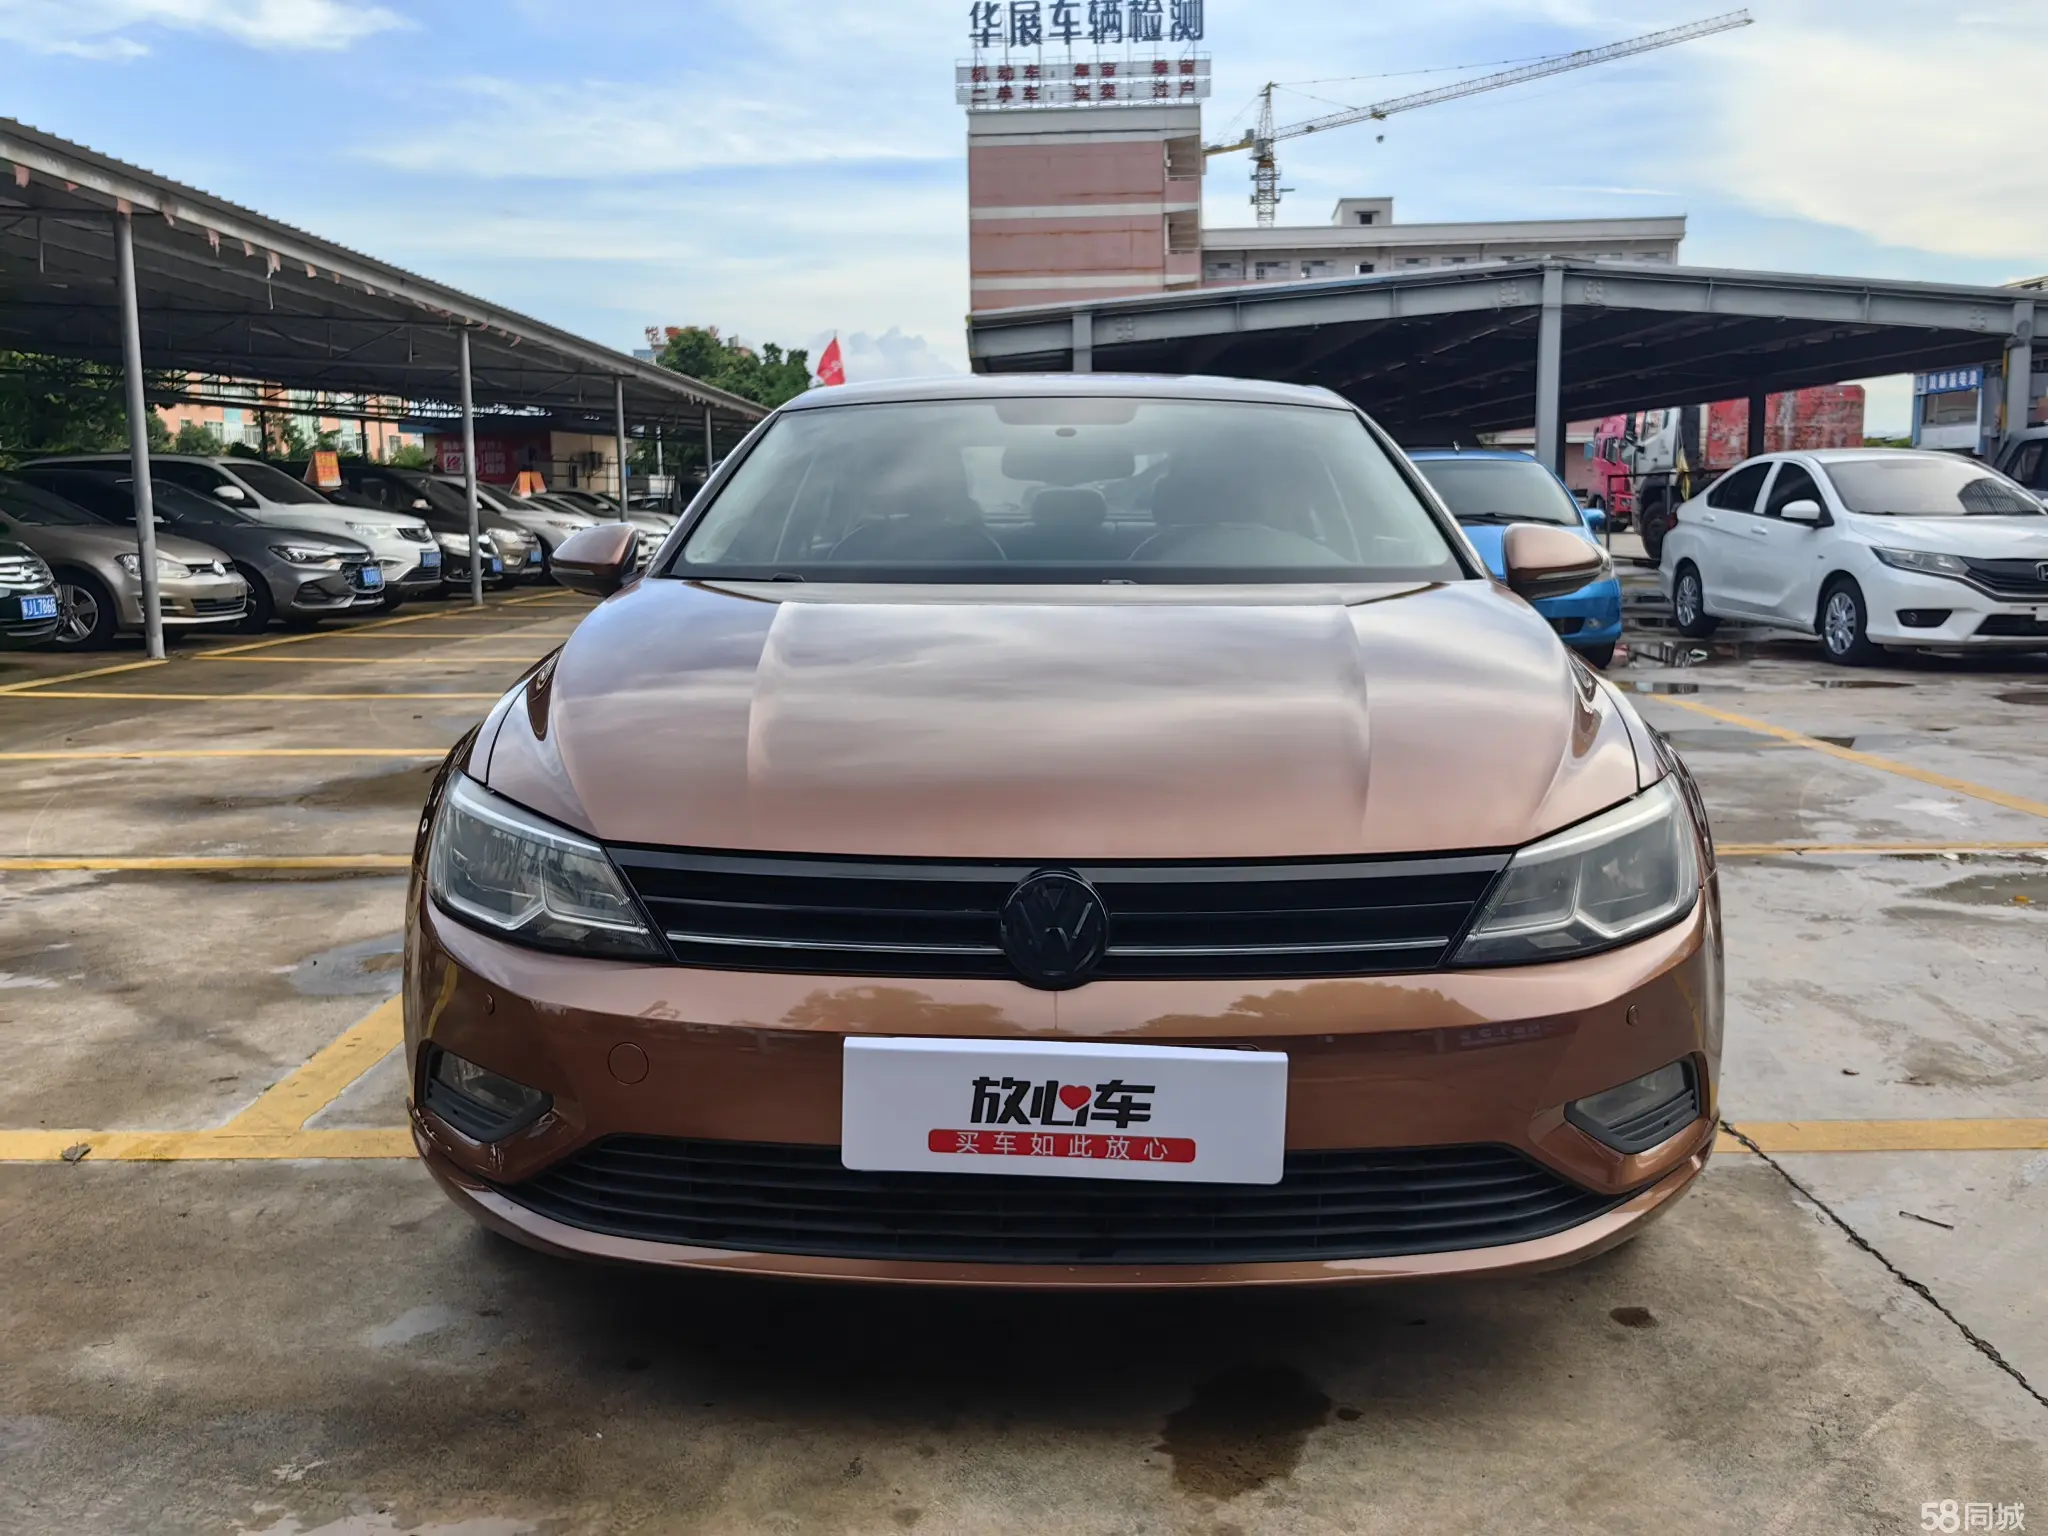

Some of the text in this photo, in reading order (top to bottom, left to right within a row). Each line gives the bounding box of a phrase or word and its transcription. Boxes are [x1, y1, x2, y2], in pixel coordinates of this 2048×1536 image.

[969, 0, 1204, 47] 华展车辆检测
[970, 1076, 1155, 1129] 放心车
[956, 1131, 1169, 1160] 买车如此放心
